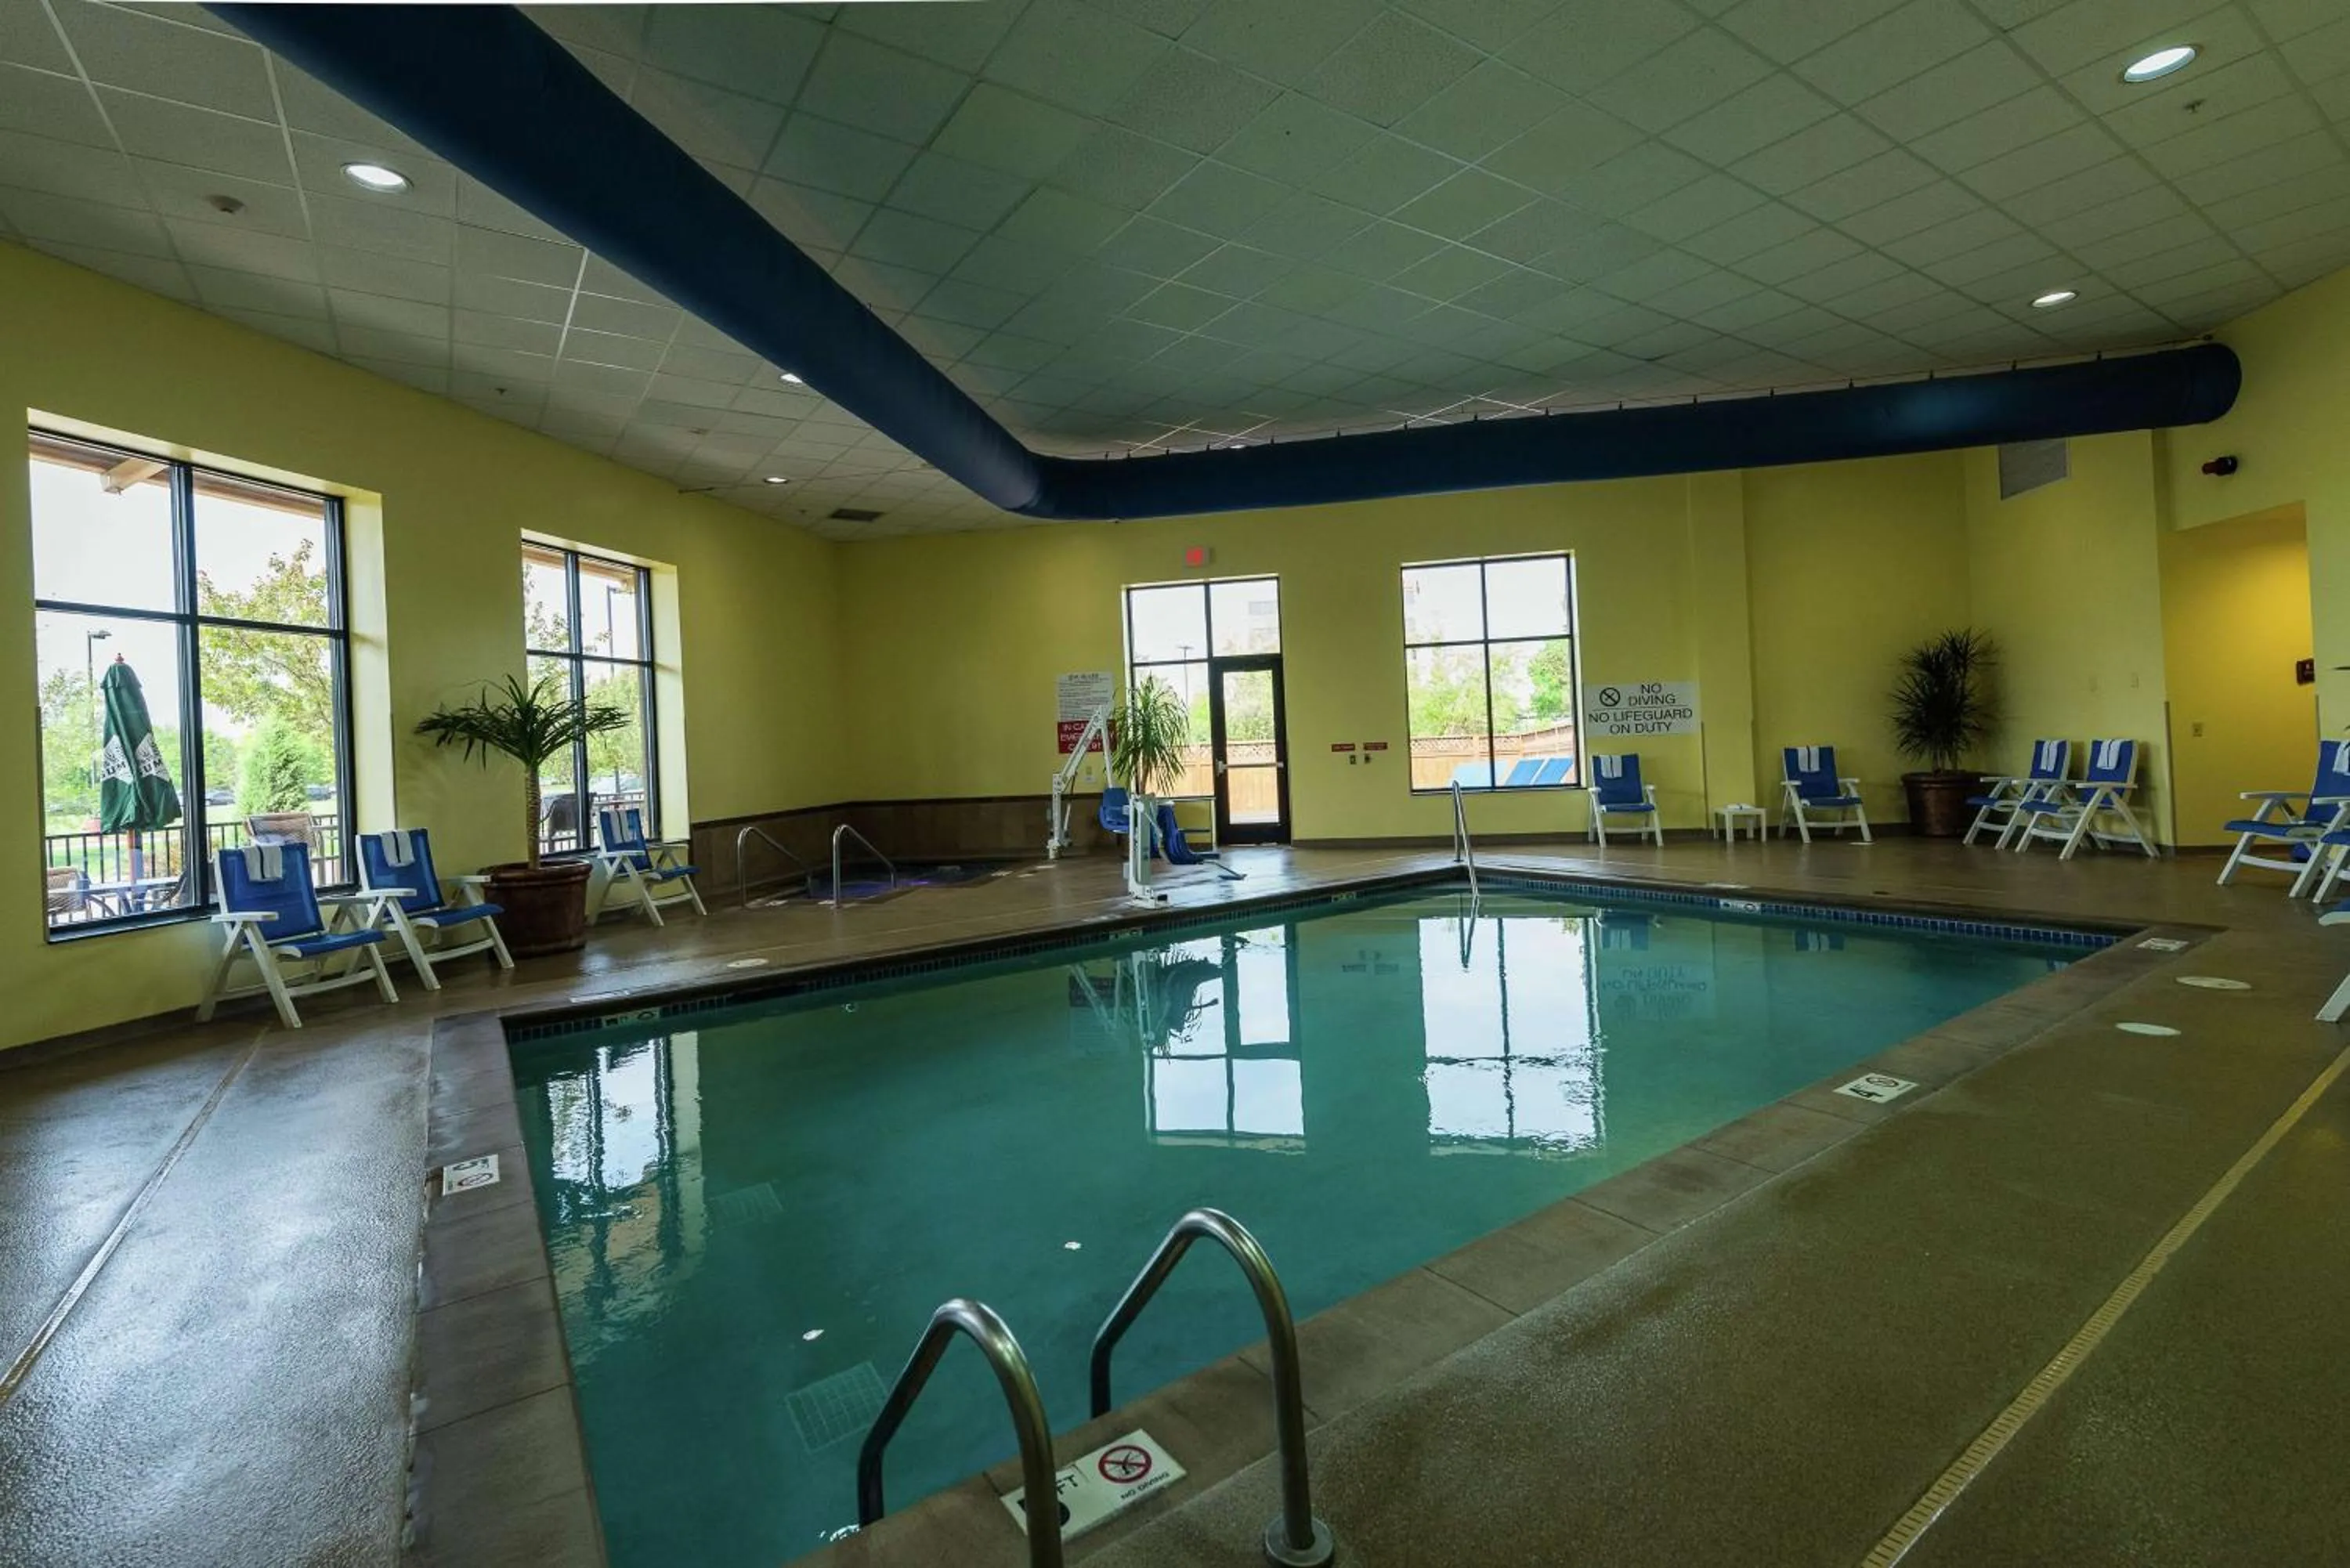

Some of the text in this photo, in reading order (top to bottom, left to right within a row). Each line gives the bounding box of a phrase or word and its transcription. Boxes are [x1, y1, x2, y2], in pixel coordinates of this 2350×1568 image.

[1641, 683, 1661, 694] NO
[1629, 694, 1676, 706] DIVING
[1589, 708, 1693, 723] NO LIFEGUARD
[1610, 721, 1672, 735] ON DUTY
[1120, 1471, 1170, 1501] NO DIVING
